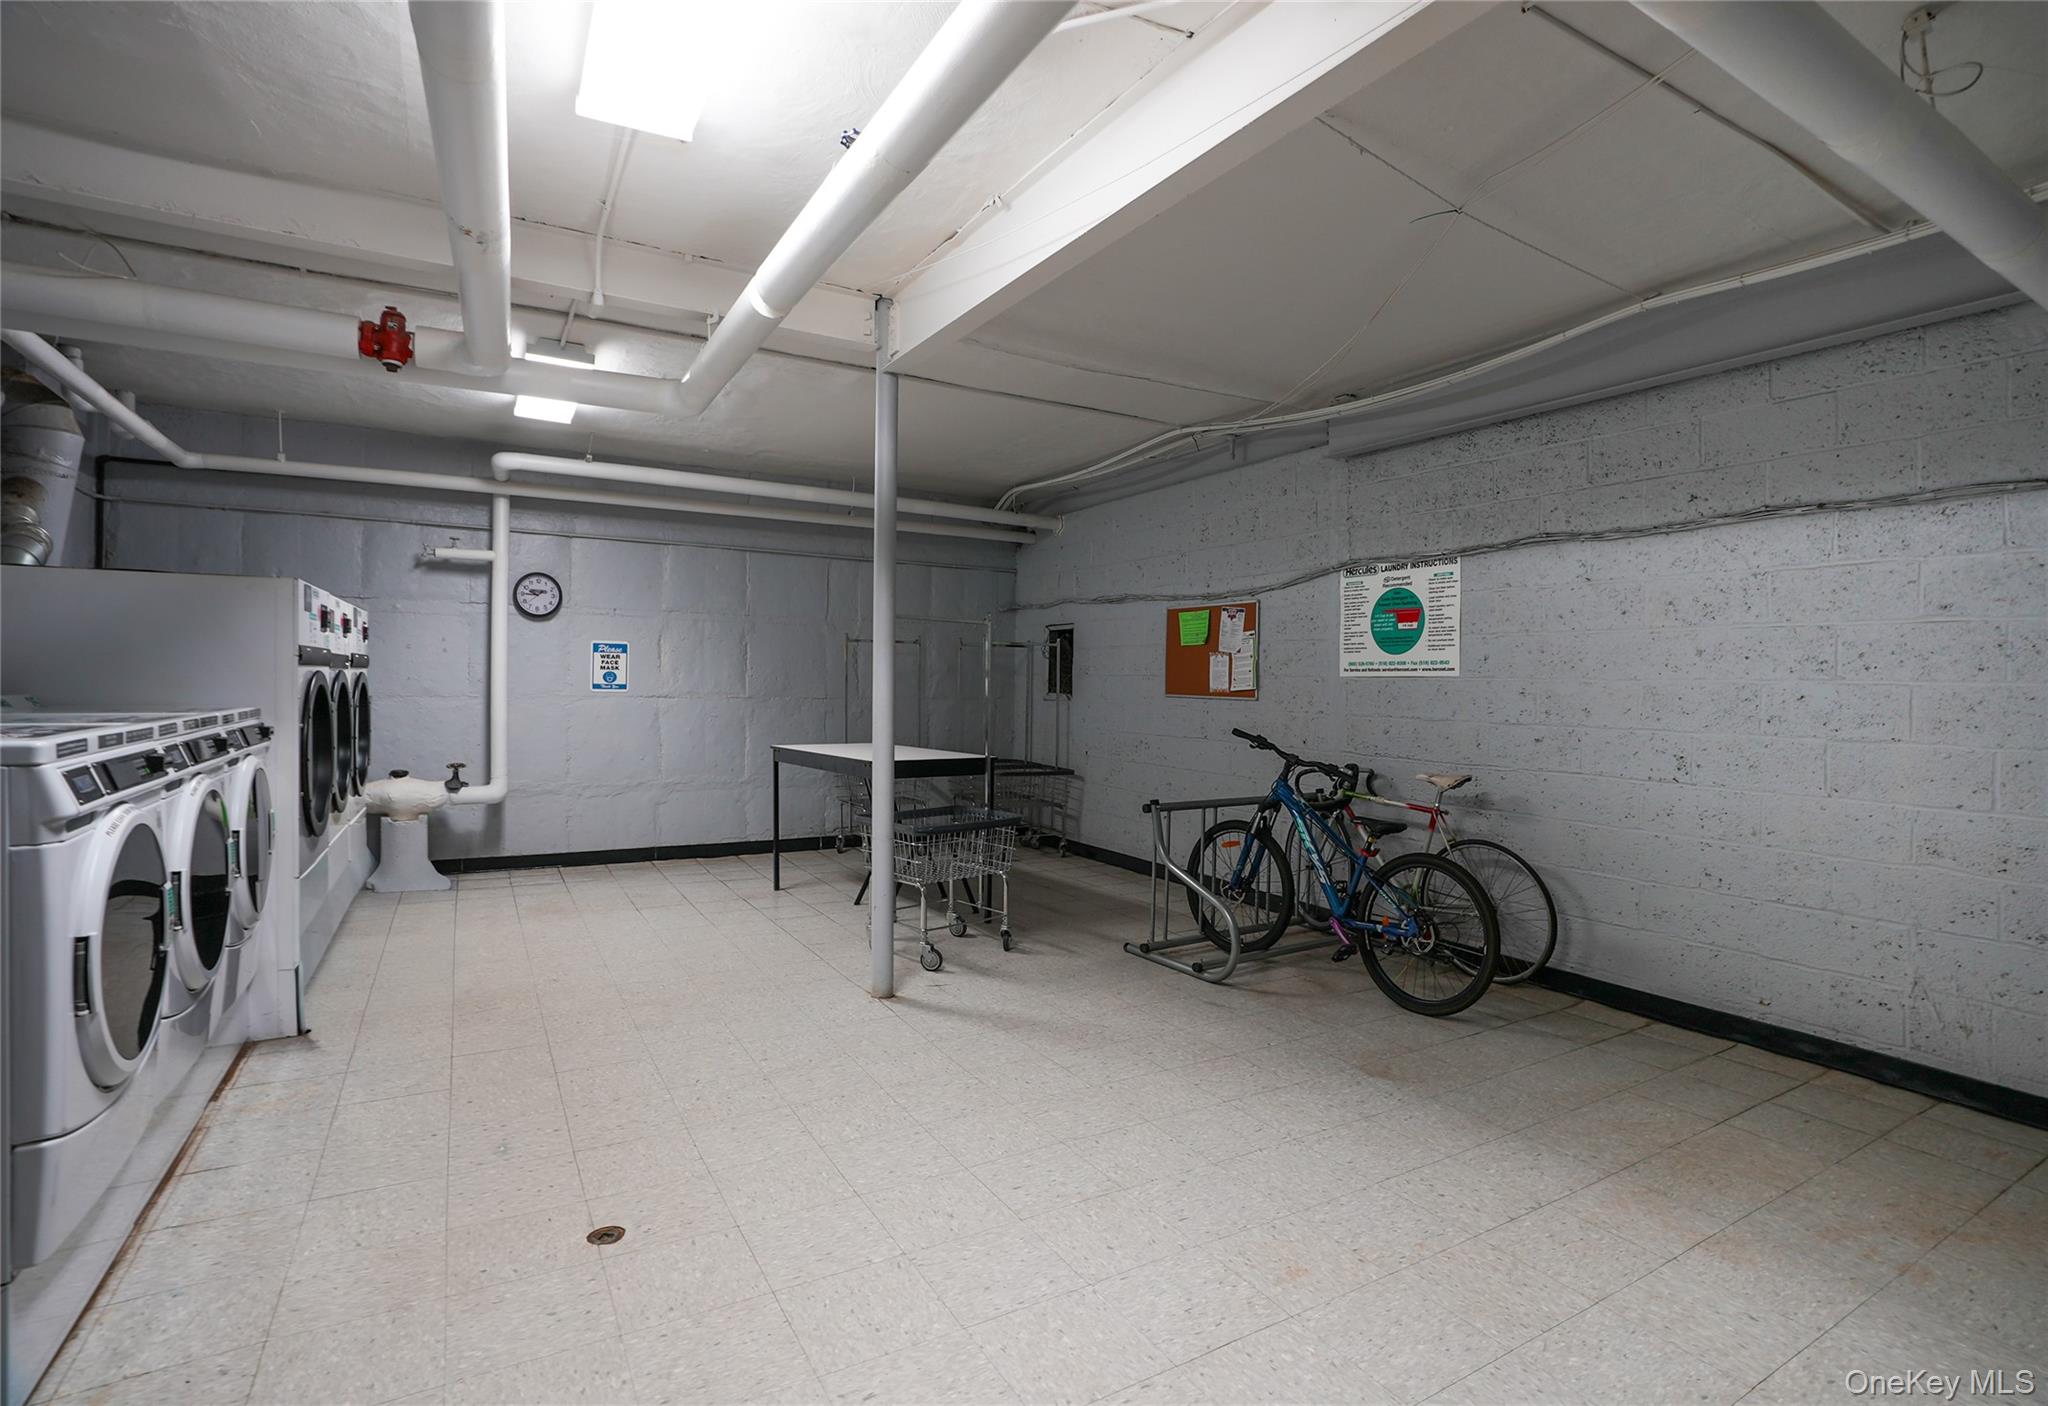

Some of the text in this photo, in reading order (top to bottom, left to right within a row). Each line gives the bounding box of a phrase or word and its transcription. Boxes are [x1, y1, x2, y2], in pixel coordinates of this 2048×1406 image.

[1345, 558, 1458, 576] Hercules LAUNDRY INSTRUCTIONS
[597, 644, 623, 653] Please
